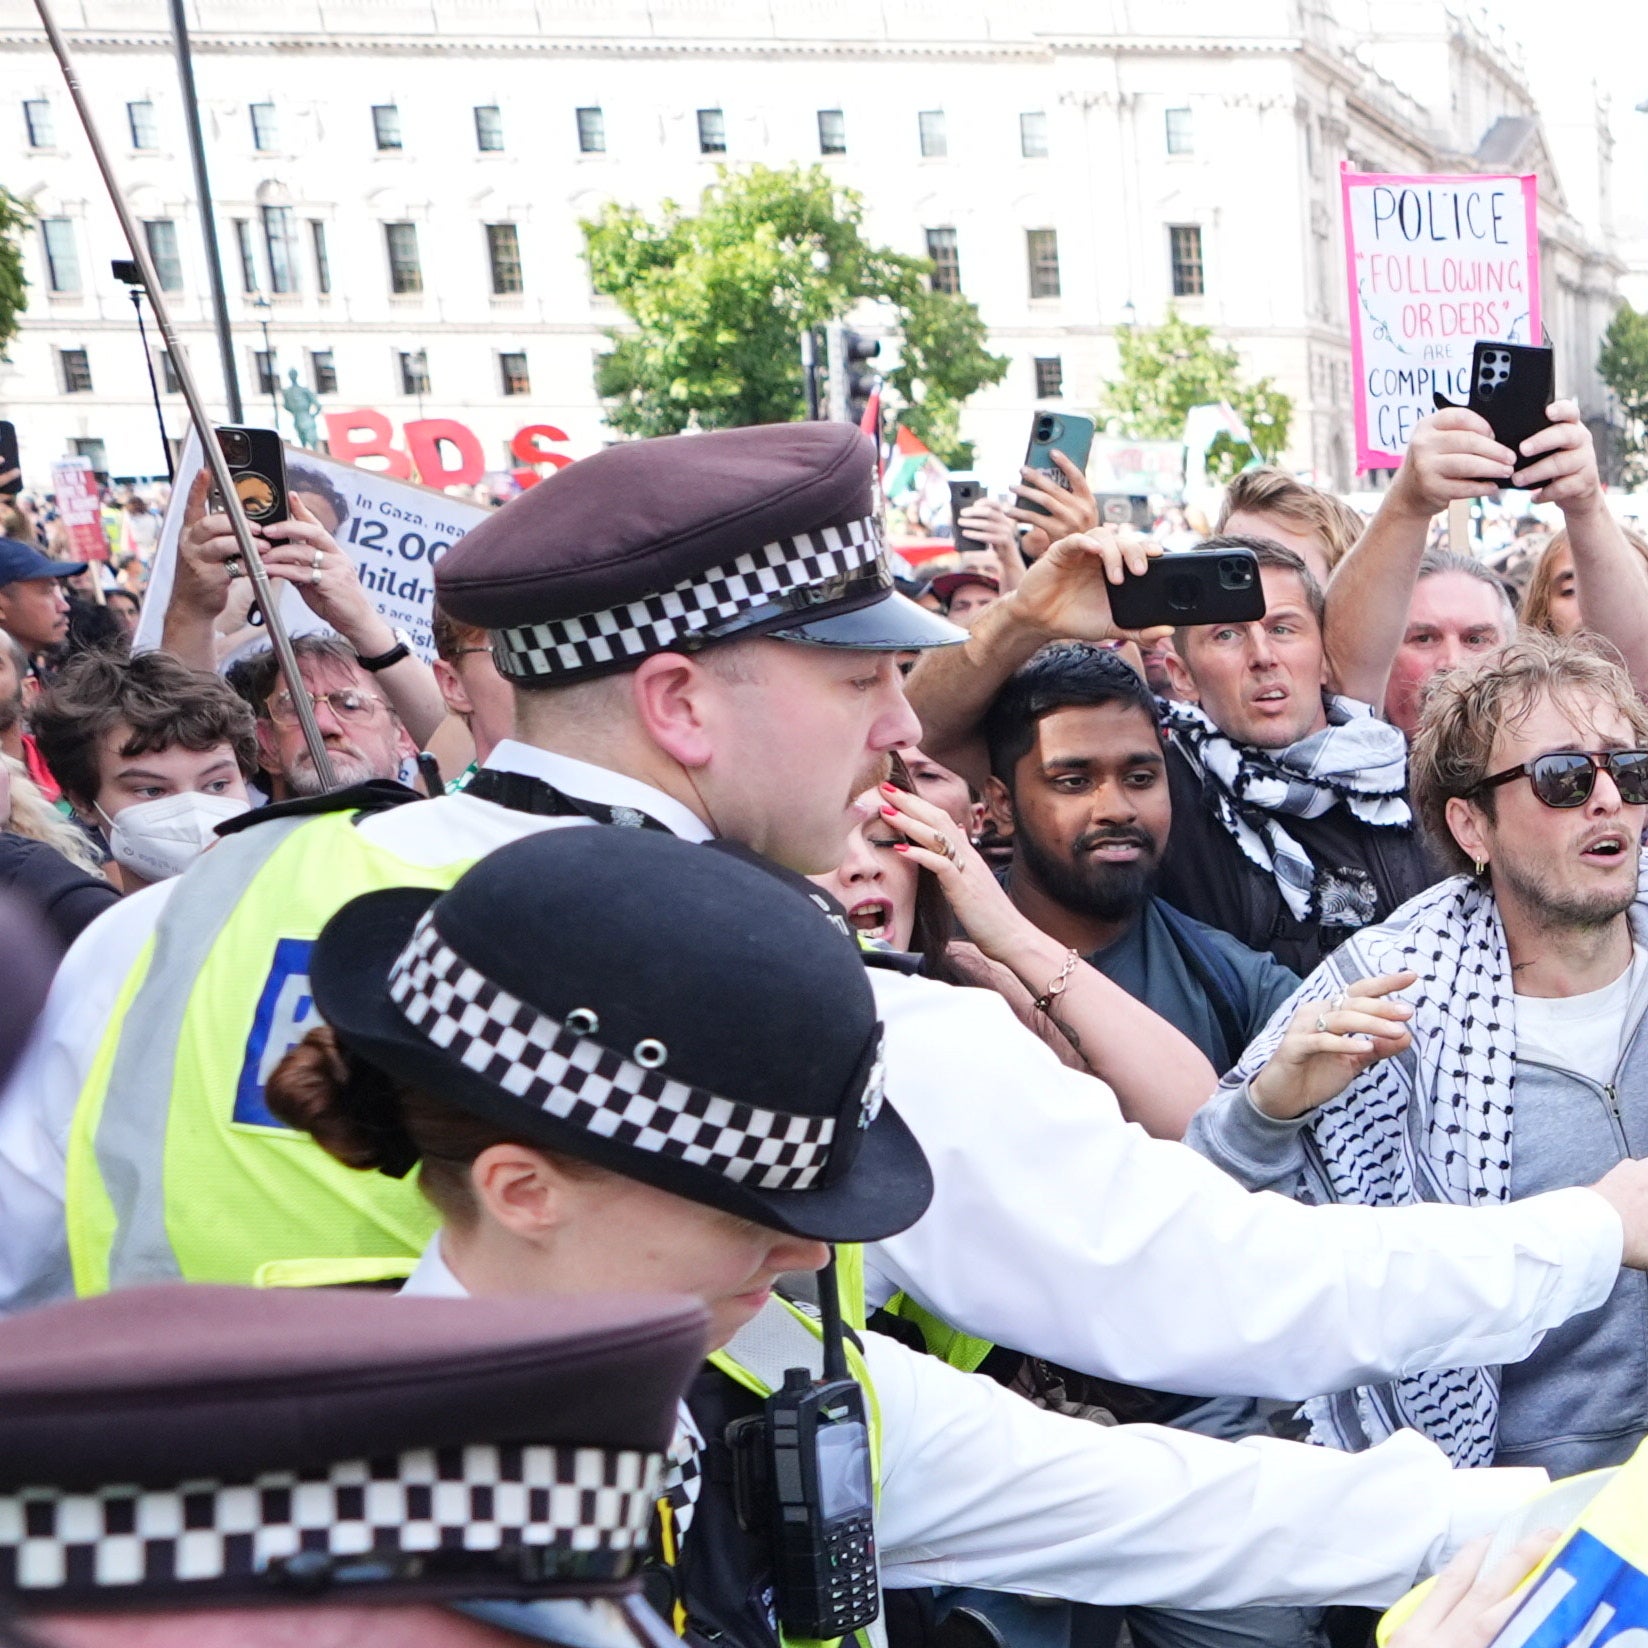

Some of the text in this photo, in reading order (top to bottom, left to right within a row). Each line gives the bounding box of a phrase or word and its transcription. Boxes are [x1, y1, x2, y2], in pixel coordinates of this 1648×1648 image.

[1373, 187, 1509, 244] POLICE
[1423, 343, 1453, 360] ARE
[1379, 404, 1436, 449] GE
[324, 408, 577, 490] BDS
[356, 493, 373, 510] In
[355, 561, 434, 604] hildr
[389, 609, 412, 623] are
